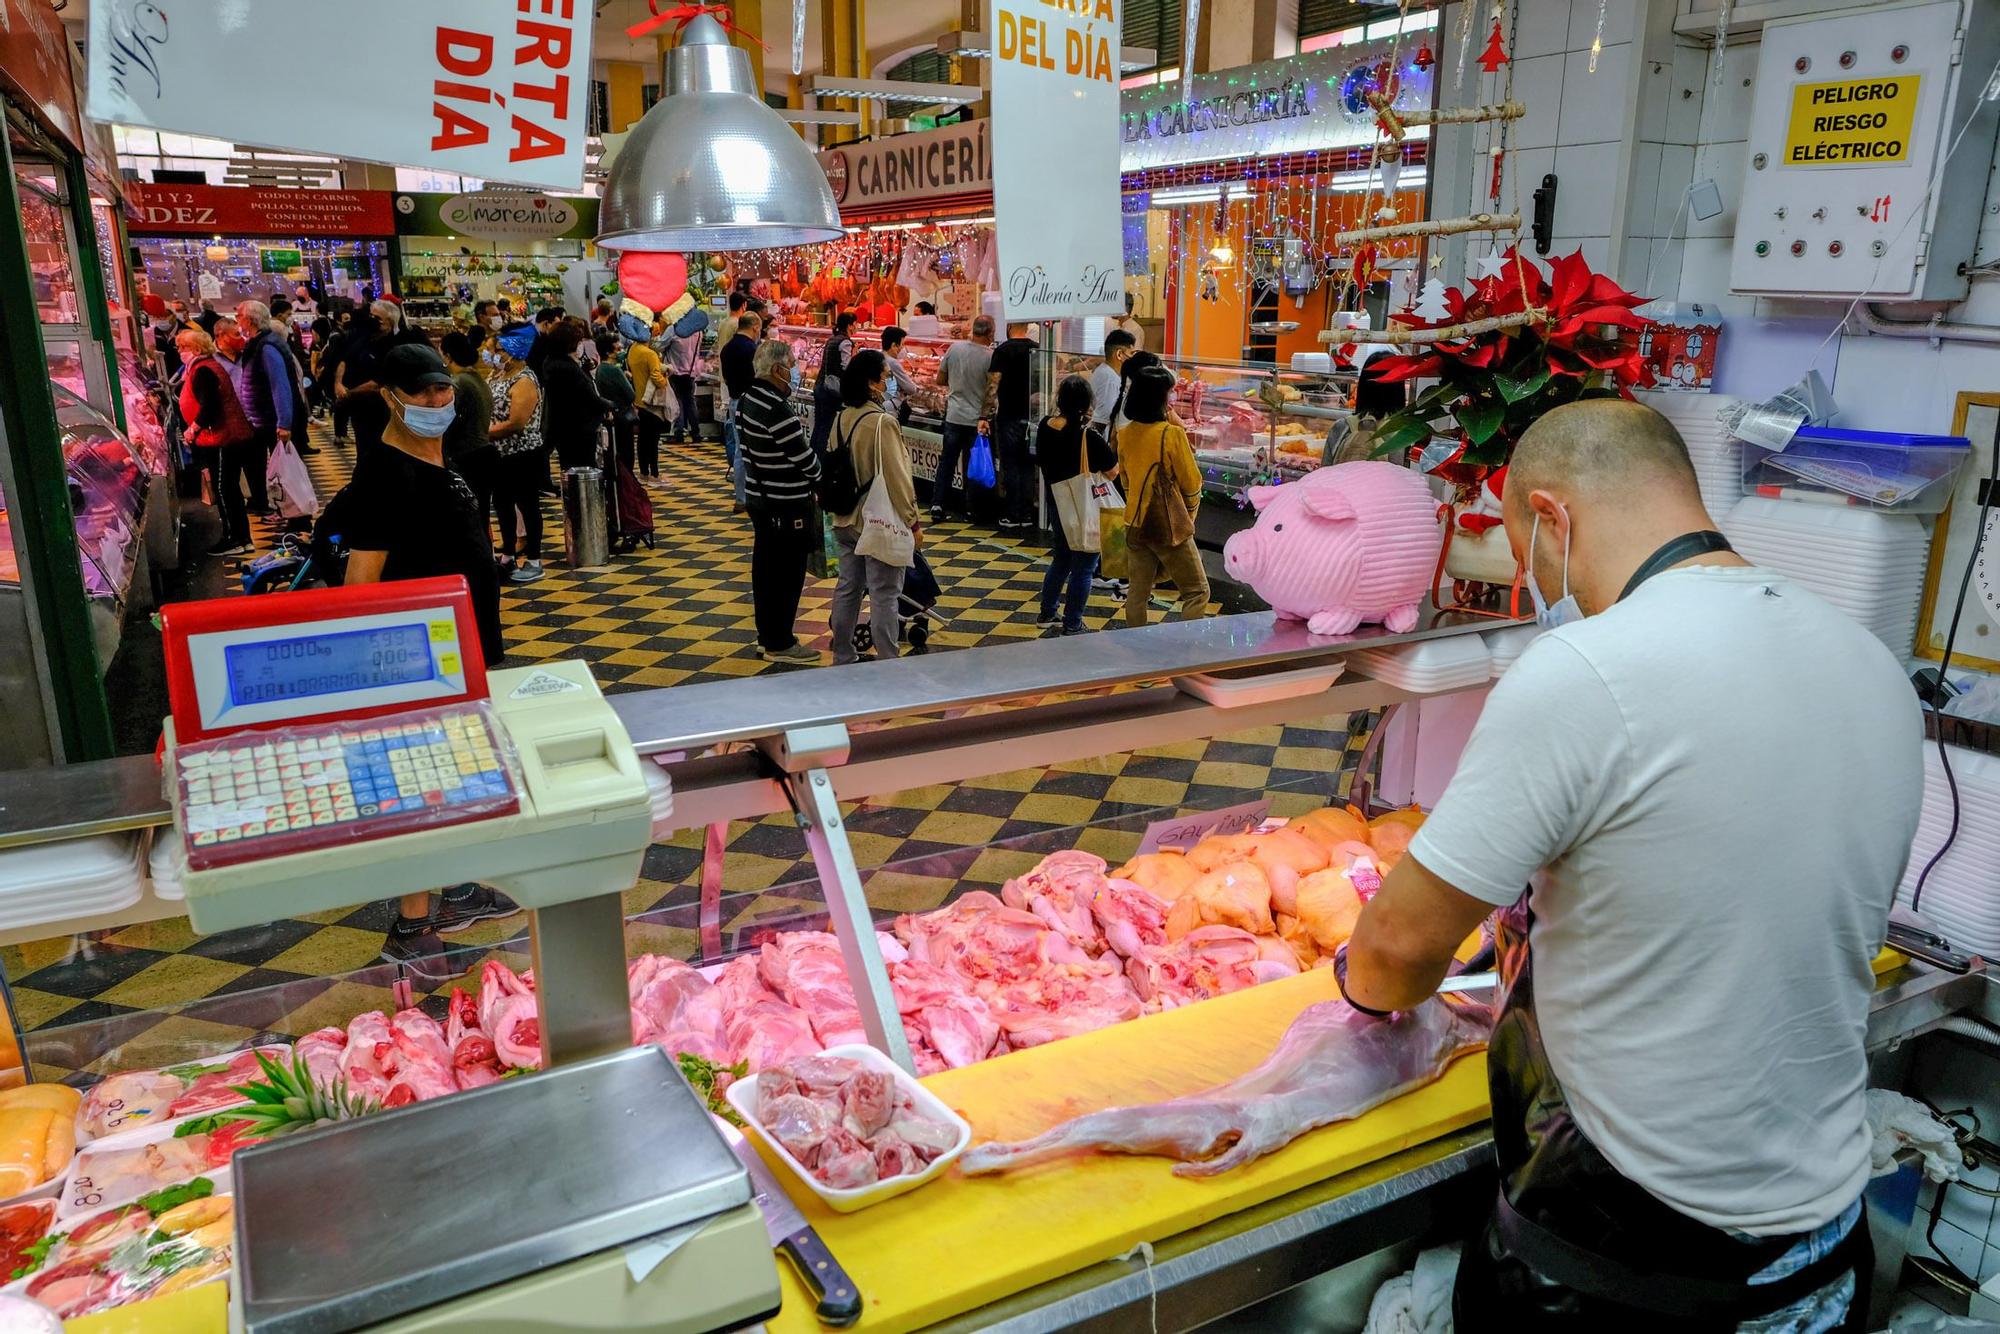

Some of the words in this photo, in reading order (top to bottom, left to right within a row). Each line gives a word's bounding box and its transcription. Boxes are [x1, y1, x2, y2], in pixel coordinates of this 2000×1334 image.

[998, 9, 1056, 71] DEL
[1066, 22, 1113, 83] DÍA
[431, 26, 505, 152] DÍA
[1812, 83, 1899, 105] PELIGRO
[1124, 110, 1152, 142] LA
[1155, 76, 1311, 137] CARNICERÍA
[1813, 112, 1888, 132] RIESGO
[857, 122, 992, 196] CARNICERÍ
[1792, 141, 1902, 161] ELÉCTRICO
[256, 192, 291, 200] TODO
[402, 200, 410, 211] 3
[145, 206, 217, 225] DEZ
[1009, 265, 1072, 307] Pollería
[1077, 265, 1118, 304] Ana
[1982, 534, 1988, 542] 3
